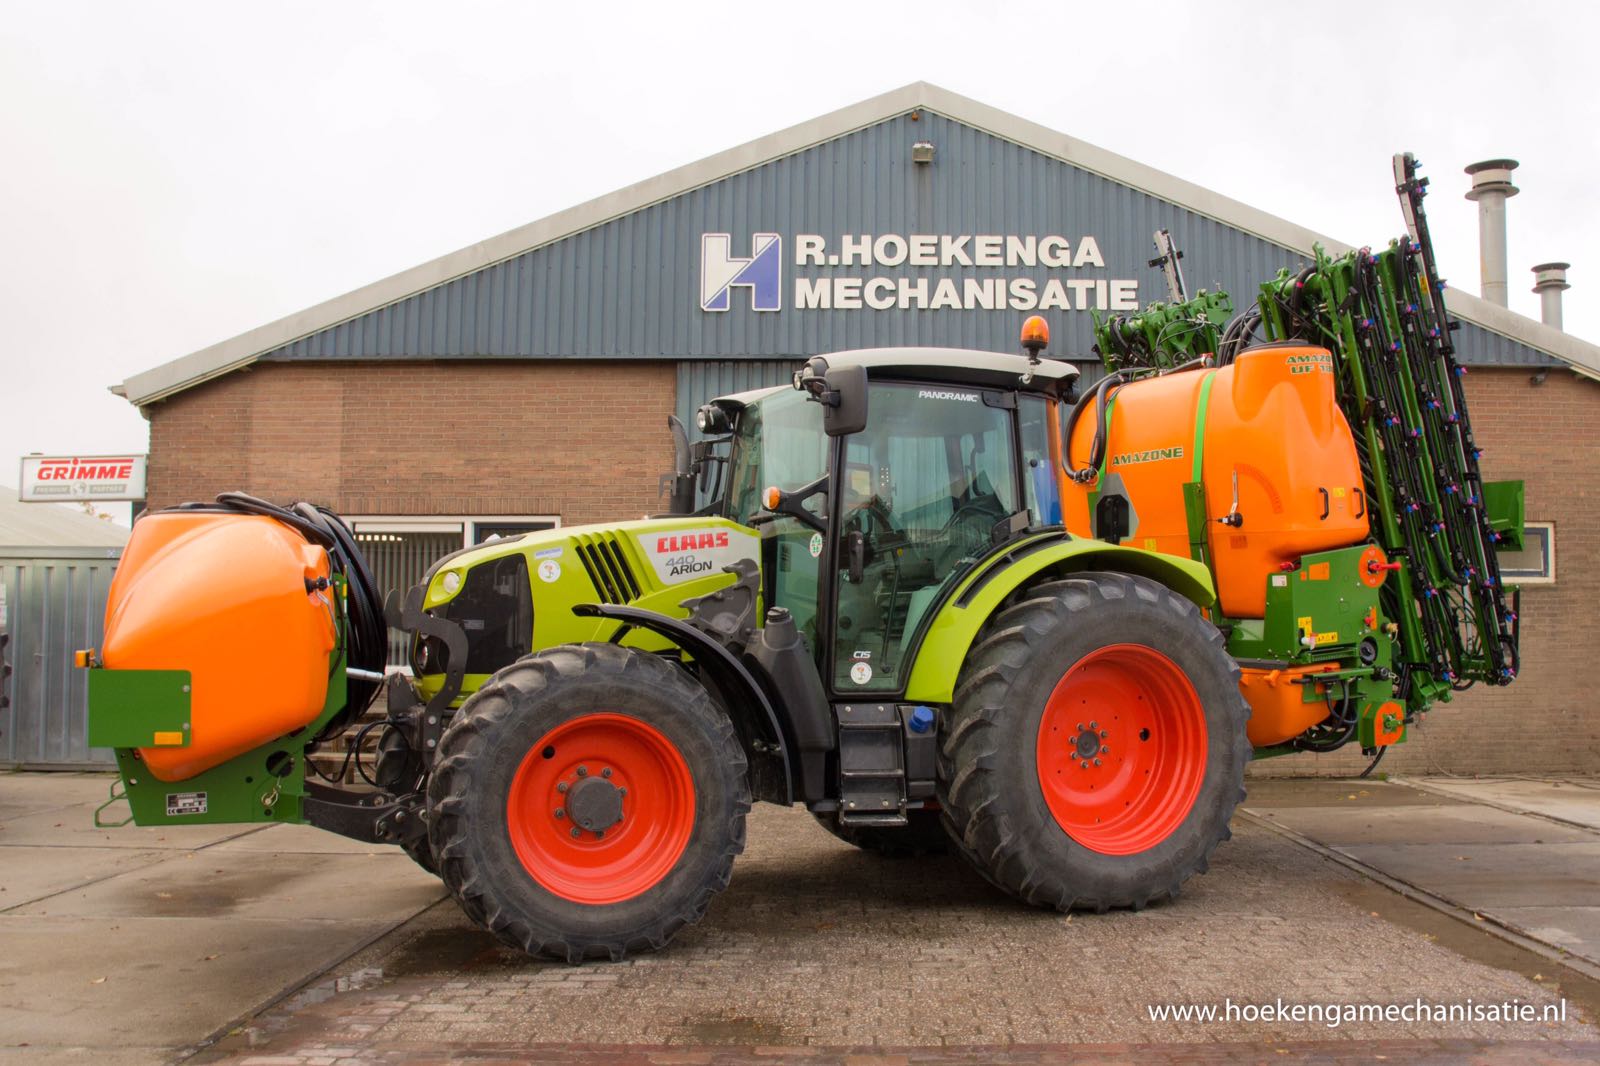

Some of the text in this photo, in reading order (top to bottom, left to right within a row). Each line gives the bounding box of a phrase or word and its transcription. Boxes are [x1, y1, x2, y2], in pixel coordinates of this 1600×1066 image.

[795, 234, 1105, 267] R.HOEKENGA
[795, 277, 1139, 312] MECHANISATIE
[919, 390, 978, 402] PANORAMIC
[1112, 447, 1183, 465] AMAZONE
[37, 464, 133, 480] GRIMME
[657, 532, 729, 553] CLAAS
[666, 555, 695, 566] 440
[670, 560, 712, 576] ARION
